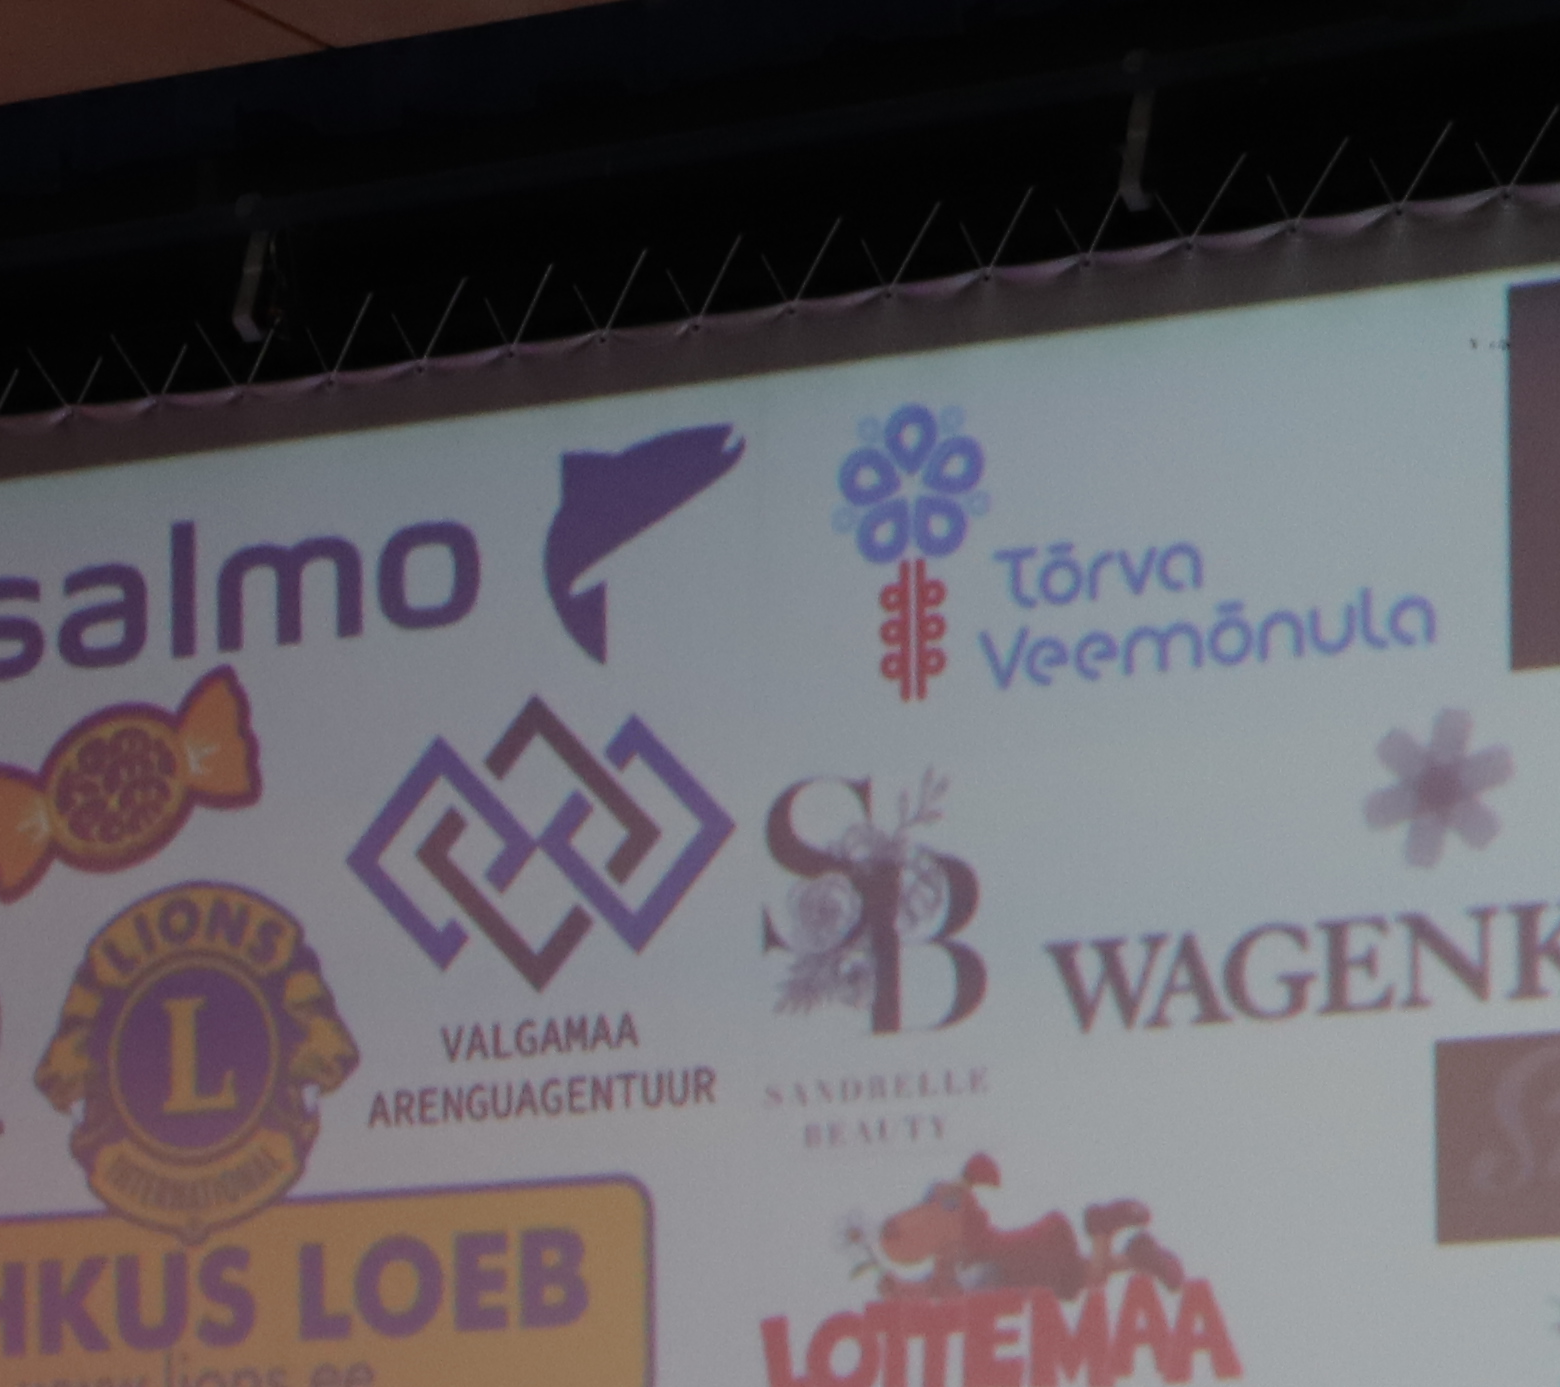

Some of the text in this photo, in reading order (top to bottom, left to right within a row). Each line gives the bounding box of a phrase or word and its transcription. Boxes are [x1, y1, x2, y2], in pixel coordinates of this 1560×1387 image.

[992, 538, 1205, 610] Tõrva
[978, 584, 1439, 693] Veemõnula
[100, 899, 286, 976] LIONS
[161, 995, 238, 1115] L
[440, 1010, 640, 1064] VALGAMAA
[367, 1064, 717, 1129] ARENGUAGENTUUR
[802, 1113, 947, 1150] BEAUTY
[297, 1225, 590, 1344] LOEB
